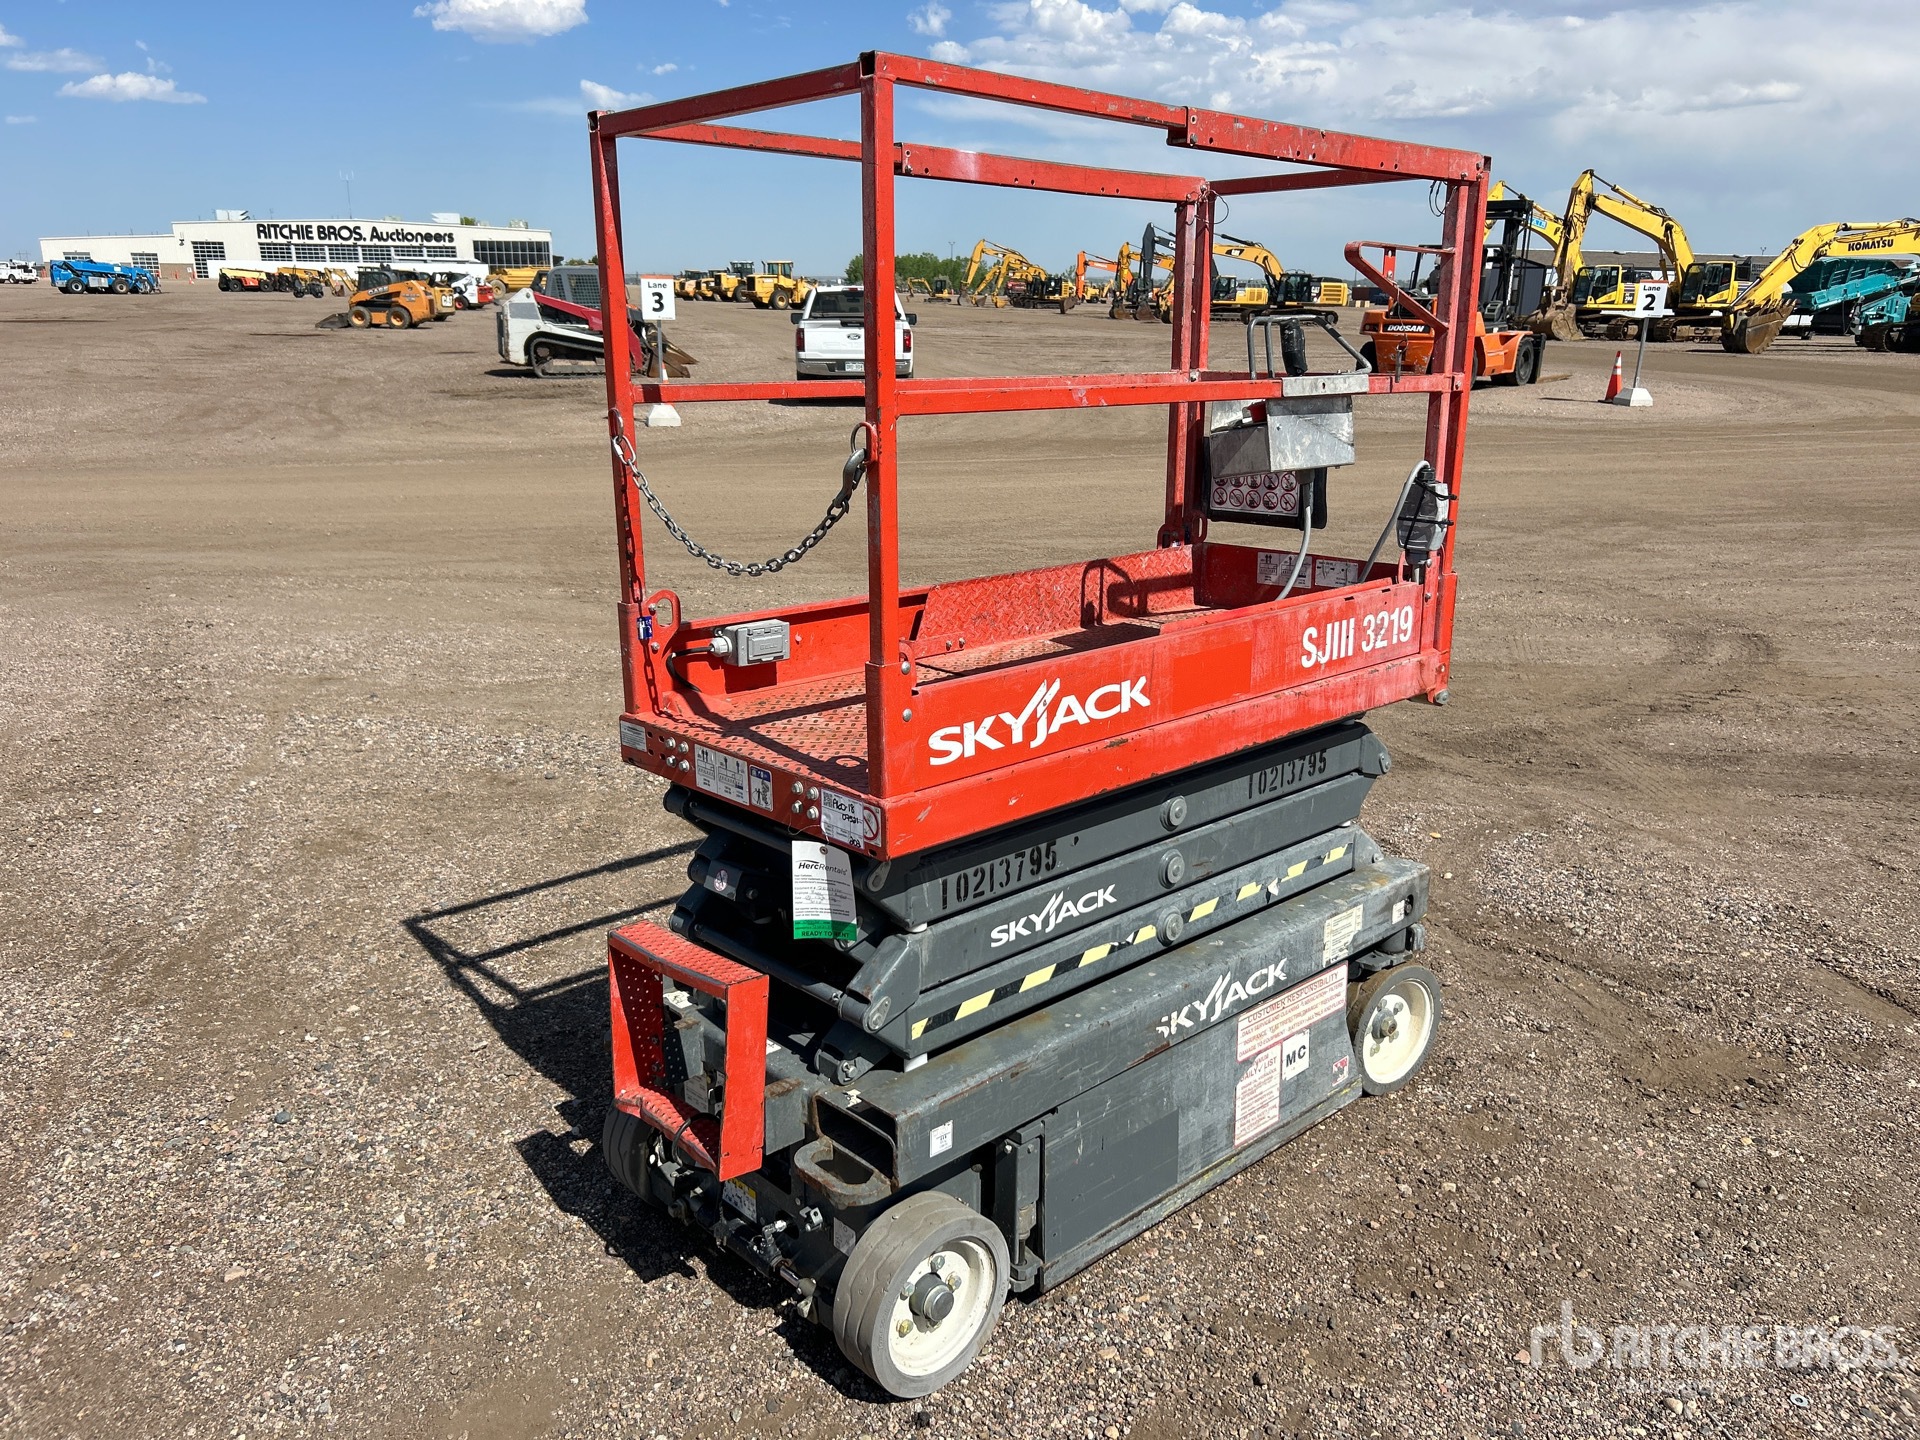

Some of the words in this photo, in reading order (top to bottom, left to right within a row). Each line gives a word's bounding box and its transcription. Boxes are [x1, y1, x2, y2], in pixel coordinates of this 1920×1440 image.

[256, 223, 313, 240] RITCHIE
[317, 225, 367, 242] BROS.
[370, 226, 454, 243] Auctioneers
[1848, 239, 1894, 251] KOMATSU
[647, 281, 667, 289] Lane
[1643, 284, 1661, 292] Lane
[652, 291, 665, 313] 3
[1642, 293, 1656, 311] 2
[1387, 324, 1424, 332] DOOSAN
[1361, 604, 1413, 653] 3219
[928, 675, 1151, 766] SKYJACK
[798, 862, 847, 876] HercRentals
[990, 883, 1117, 948] SKYJACK
[1246, 1000, 1286, 1024] CUSTOMER
[1286, 972, 1338, 1004] RESPONSIBILITY
[1263, 1055, 1277, 1069] LIST
[1286, 1045, 1307, 1067] MC
